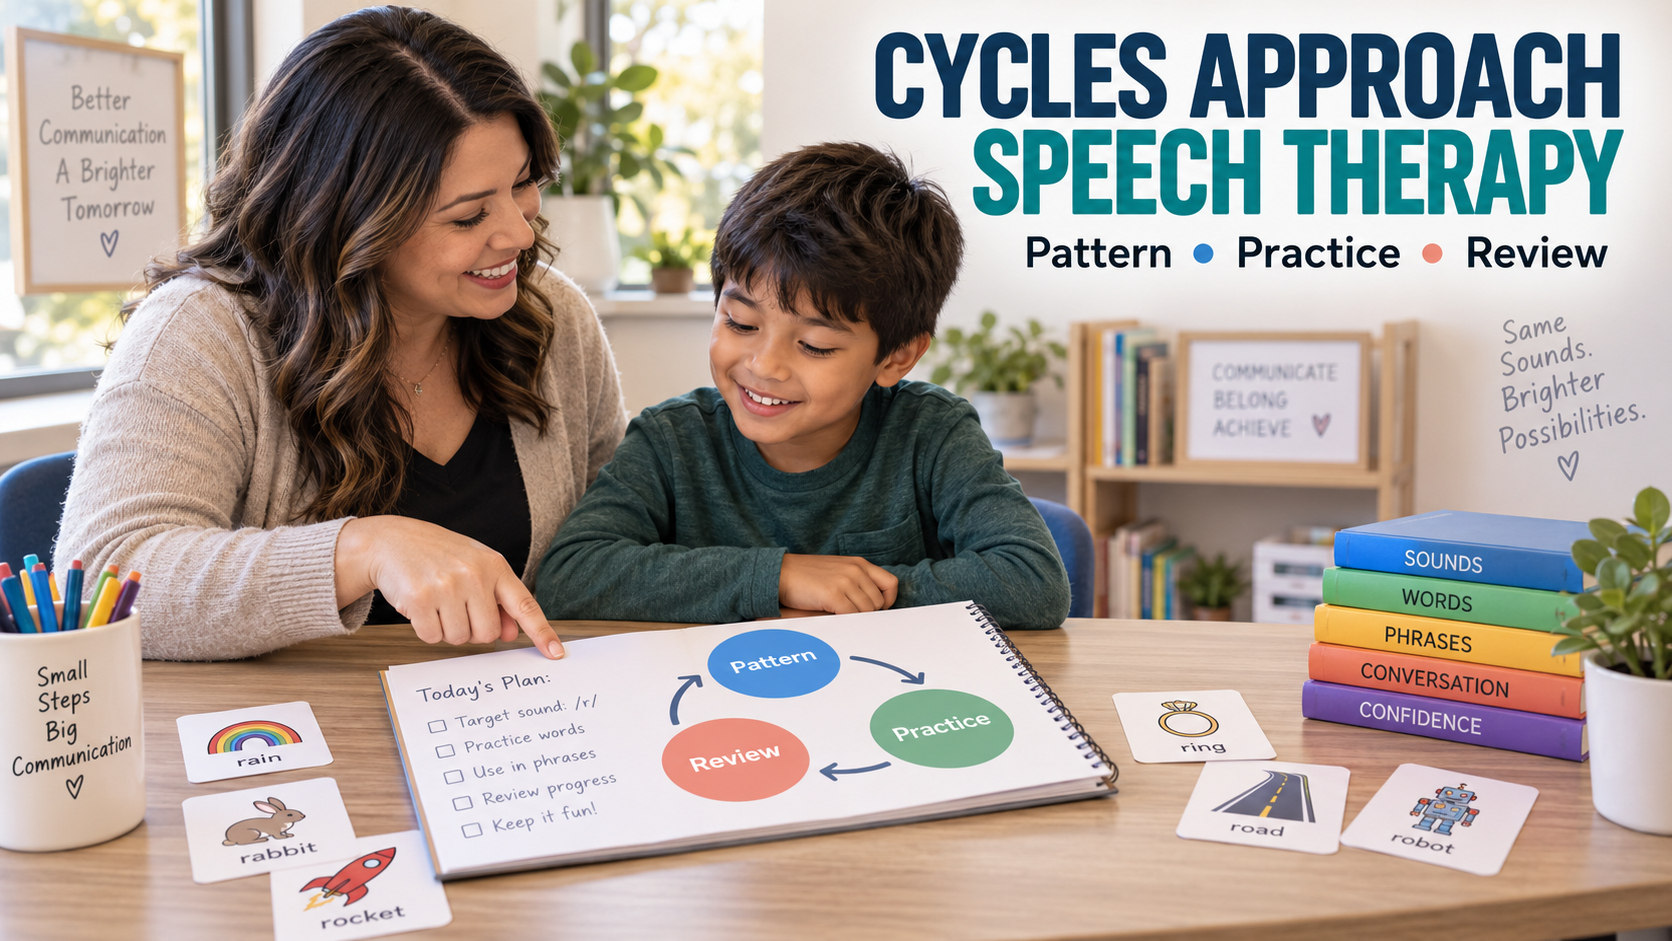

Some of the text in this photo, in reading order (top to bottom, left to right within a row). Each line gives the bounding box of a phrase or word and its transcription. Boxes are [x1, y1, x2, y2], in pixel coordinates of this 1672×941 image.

[71, 85, 131, 110] Better
[39, 119, 166, 145] Communication
[56, 157, 155, 191] A Brighter
[60, 195, 154, 222] Tomorrow
[1503, 316, 1567, 344] Same
[1501, 336, 1592, 376] Sounds.
[1212, 363, 1338, 381] COMMUNICATE
[1213, 390, 1288, 410] BELONG
[1501, 371, 1605, 413] Brighter
[1212, 419, 1292, 438] ACHIEVE
[1499, 403, 1646, 454] Possibilities.
[1404, 550, 1483, 574] SOUNDS
[1402, 588, 1473, 612] WORDS
[1385, 626, 1472, 653] PHRASES
[37, 659, 87, 687] Small
[730, 649, 817, 674] Pattern
[416, 674, 551, 702] Today's Plan:
[1361, 662, 1509, 698] CONVERSATION
[38, 691, 90, 714] Steps
[455, 694, 597, 728] Target sound: /r/
[892, 713, 991, 742] Practice
[1359, 701, 1482, 736] CONFIDENCE
[46, 720, 77, 745] Big
[464, 723, 585, 753] Practice words
[12, 735, 132, 777] Communication
[237, 754, 282, 767] rain
[689, 745, 781, 773] Review
[1181, 742, 1226, 755] ring
[473, 750, 597, 779] Use in phrases
[483, 774, 617, 805] Review progress
[492, 801, 598, 833] Keep it fun!
[1230, 821, 1285, 838] road
[240, 843, 318, 864] rabbit
[1391, 832, 1454, 855] robot
[321, 906, 406, 929] rocket
